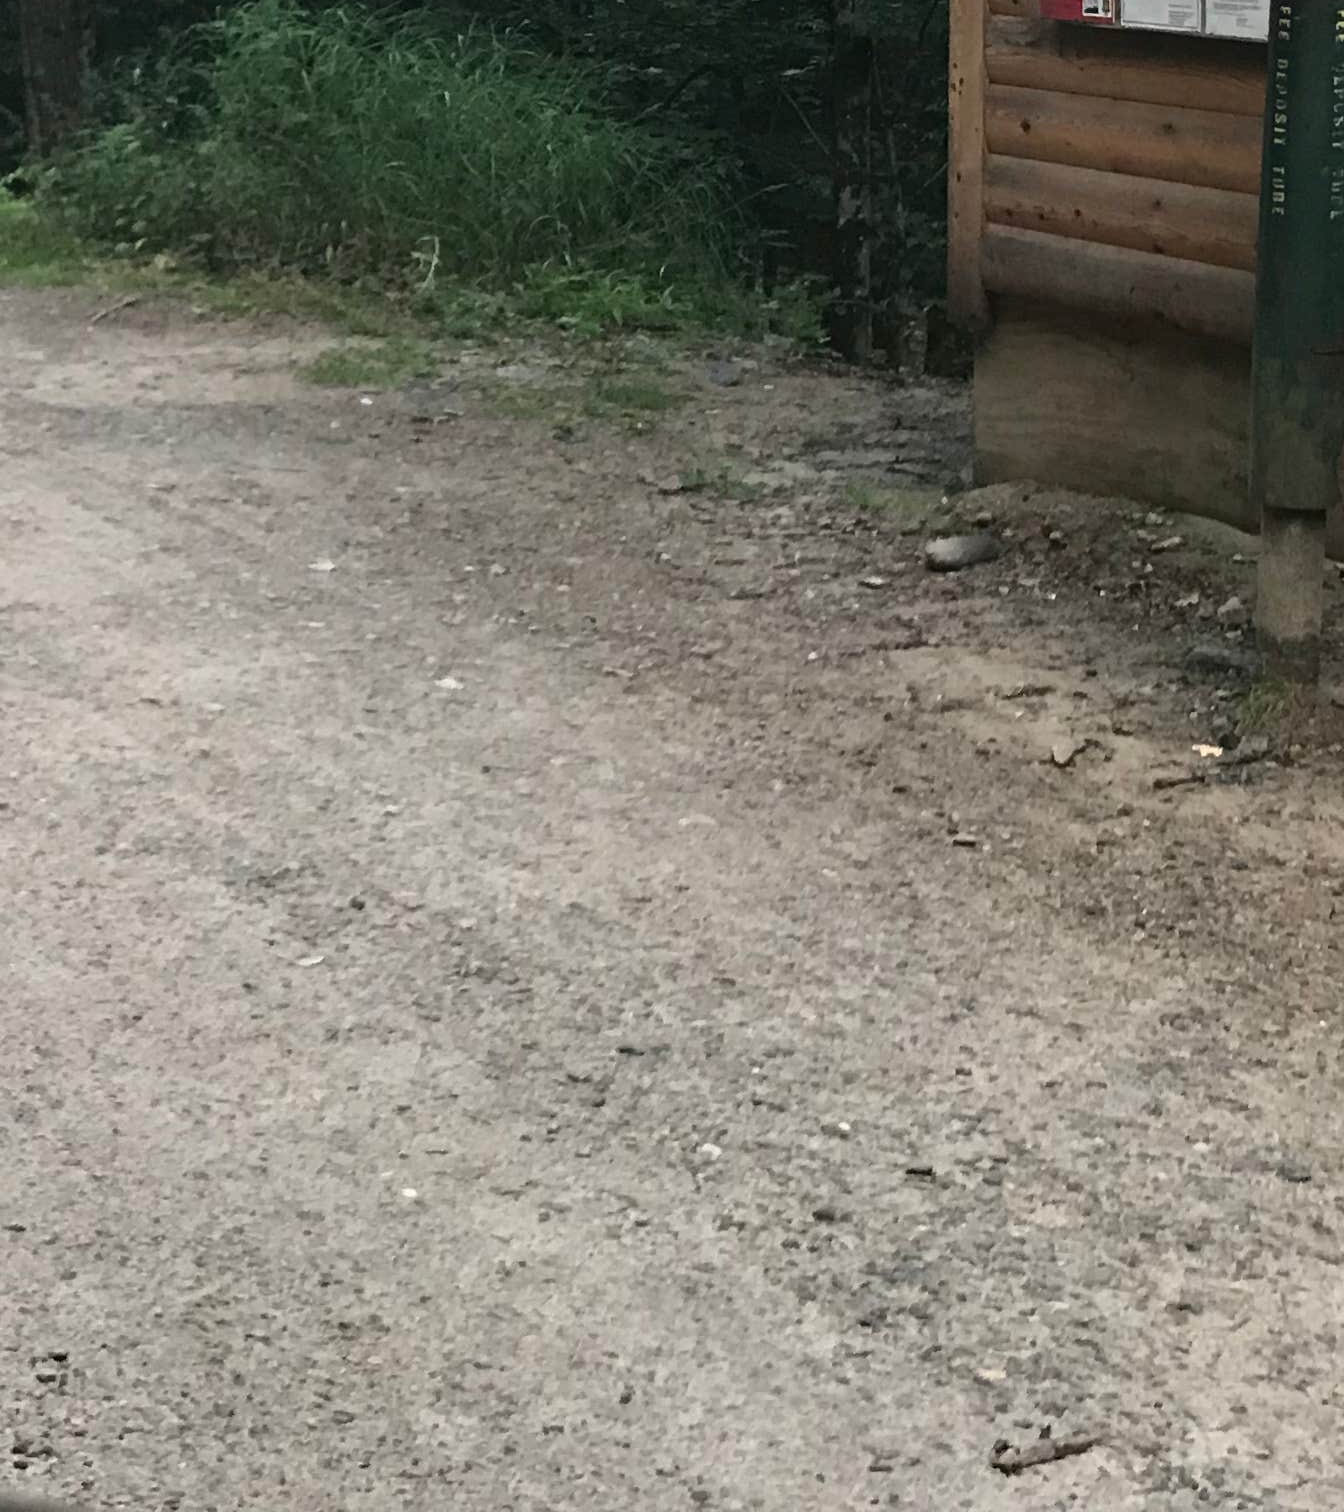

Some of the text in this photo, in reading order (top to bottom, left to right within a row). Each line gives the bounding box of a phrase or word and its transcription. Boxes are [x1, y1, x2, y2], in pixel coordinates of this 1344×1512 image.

[1272, 6, 1292, 216] FEE DEPOSIT TUBE
